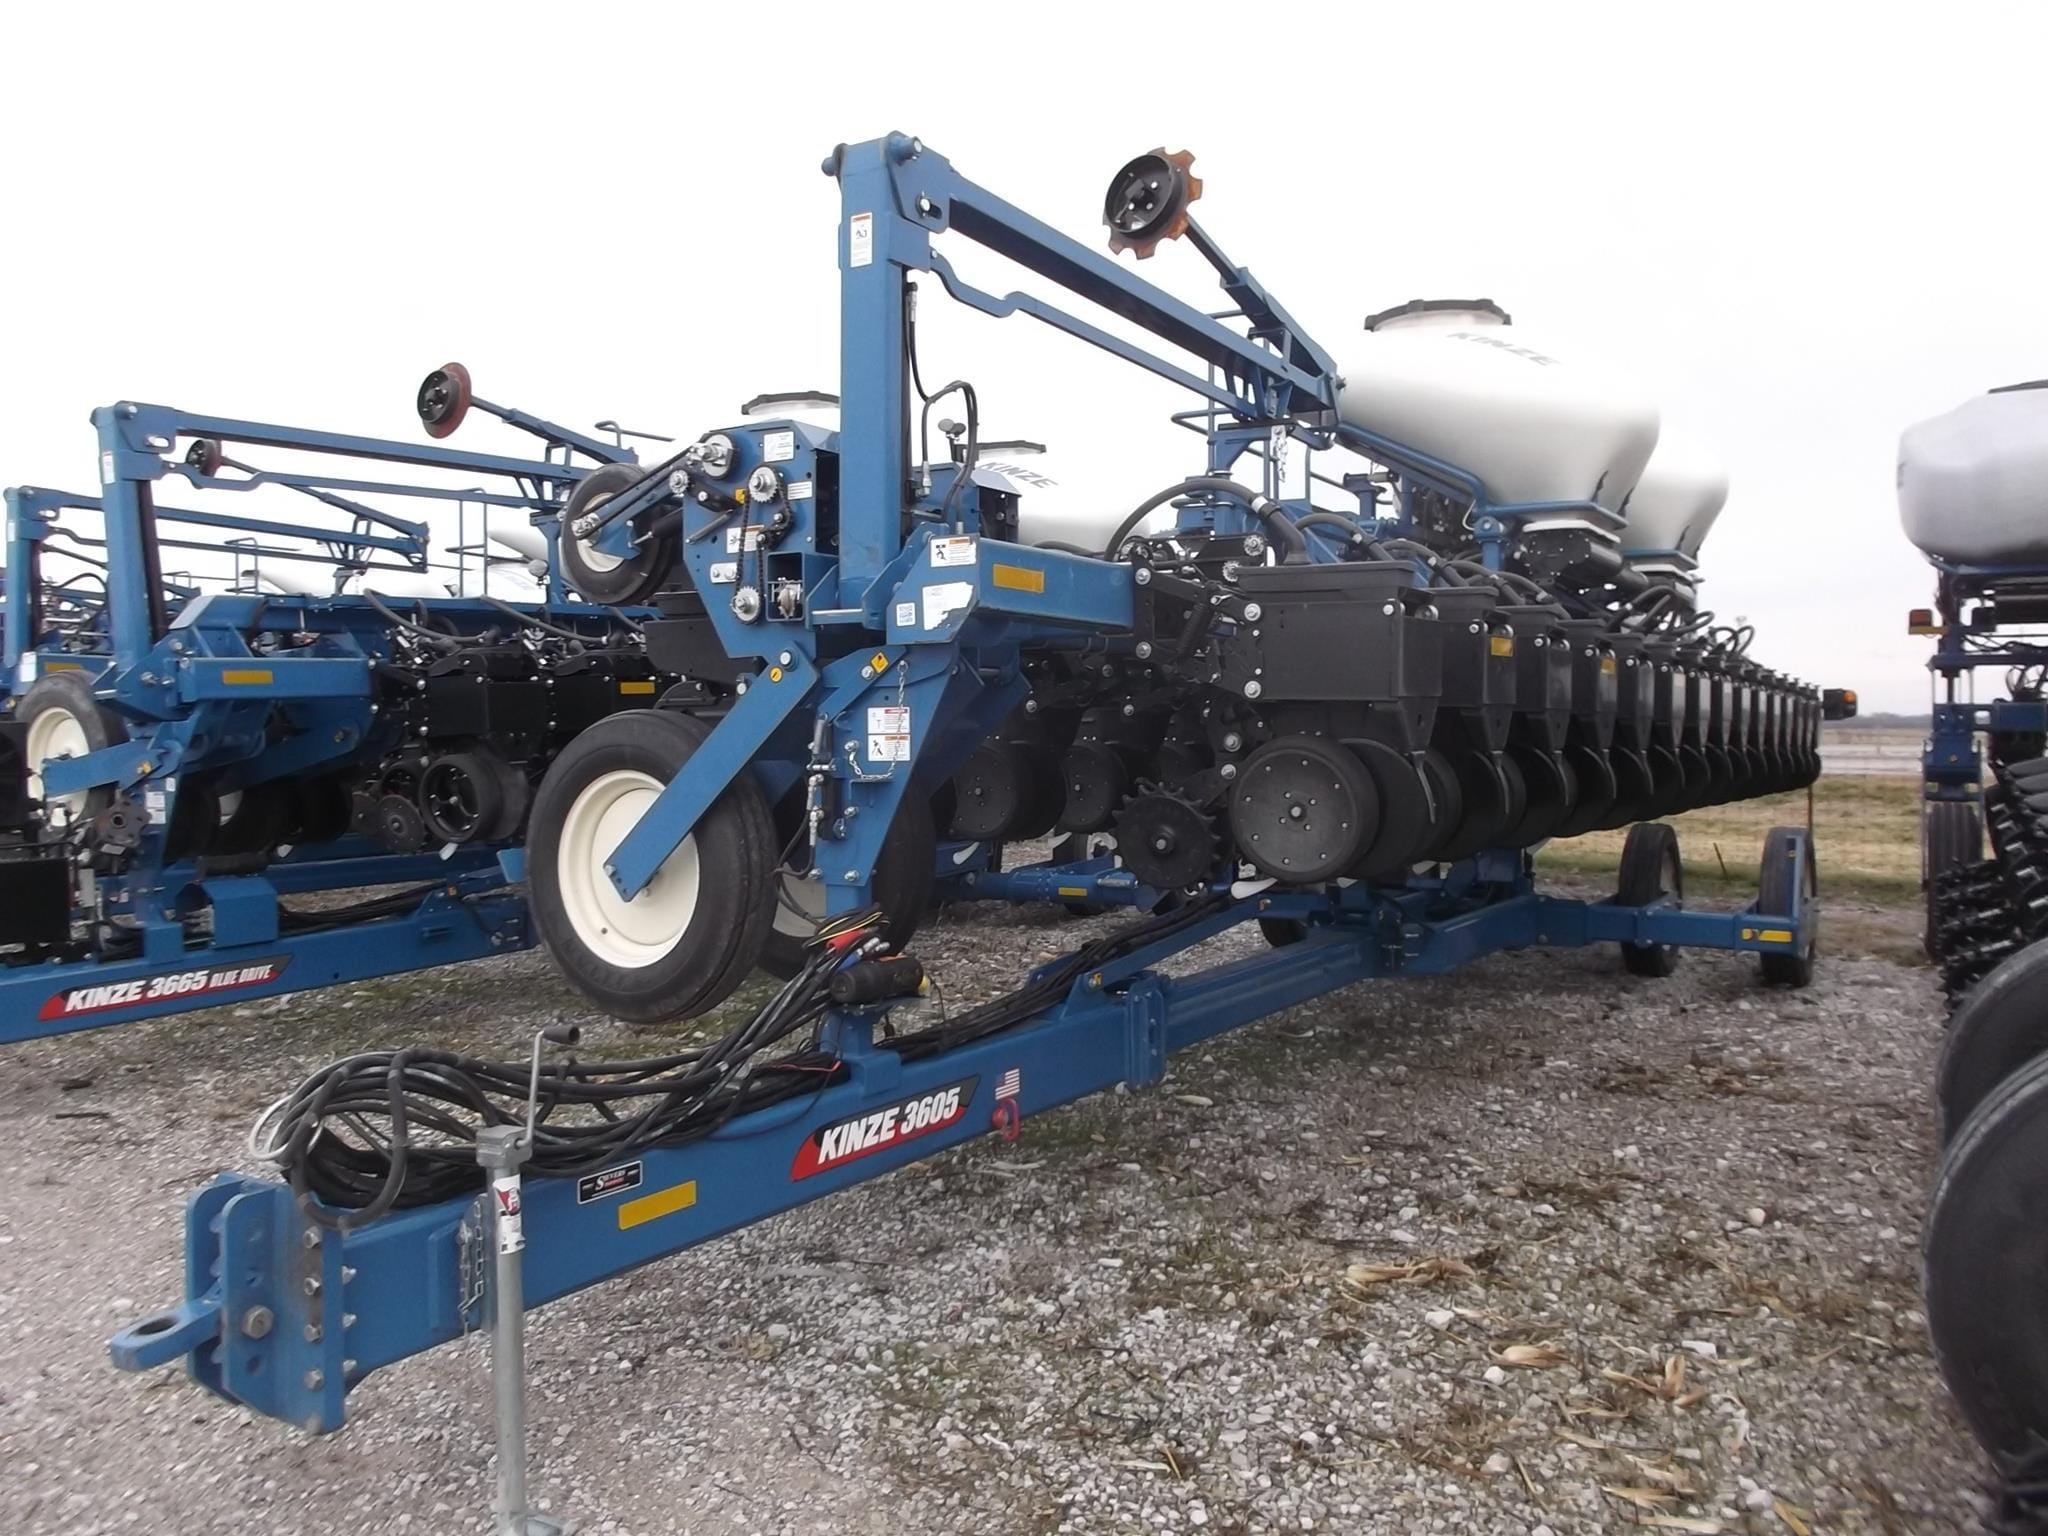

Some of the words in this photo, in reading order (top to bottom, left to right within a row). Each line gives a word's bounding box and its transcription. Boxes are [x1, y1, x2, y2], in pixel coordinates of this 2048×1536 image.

[1445, 332, 1562, 367] KINZE
[978, 462, 1059, 489] KINZE
[65, 980, 148, 1013] KINZE
[148, 970, 210, 998] 3665
[817, 1106, 900, 1165] KINZE
[900, 1086, 961, 1135] 3605
